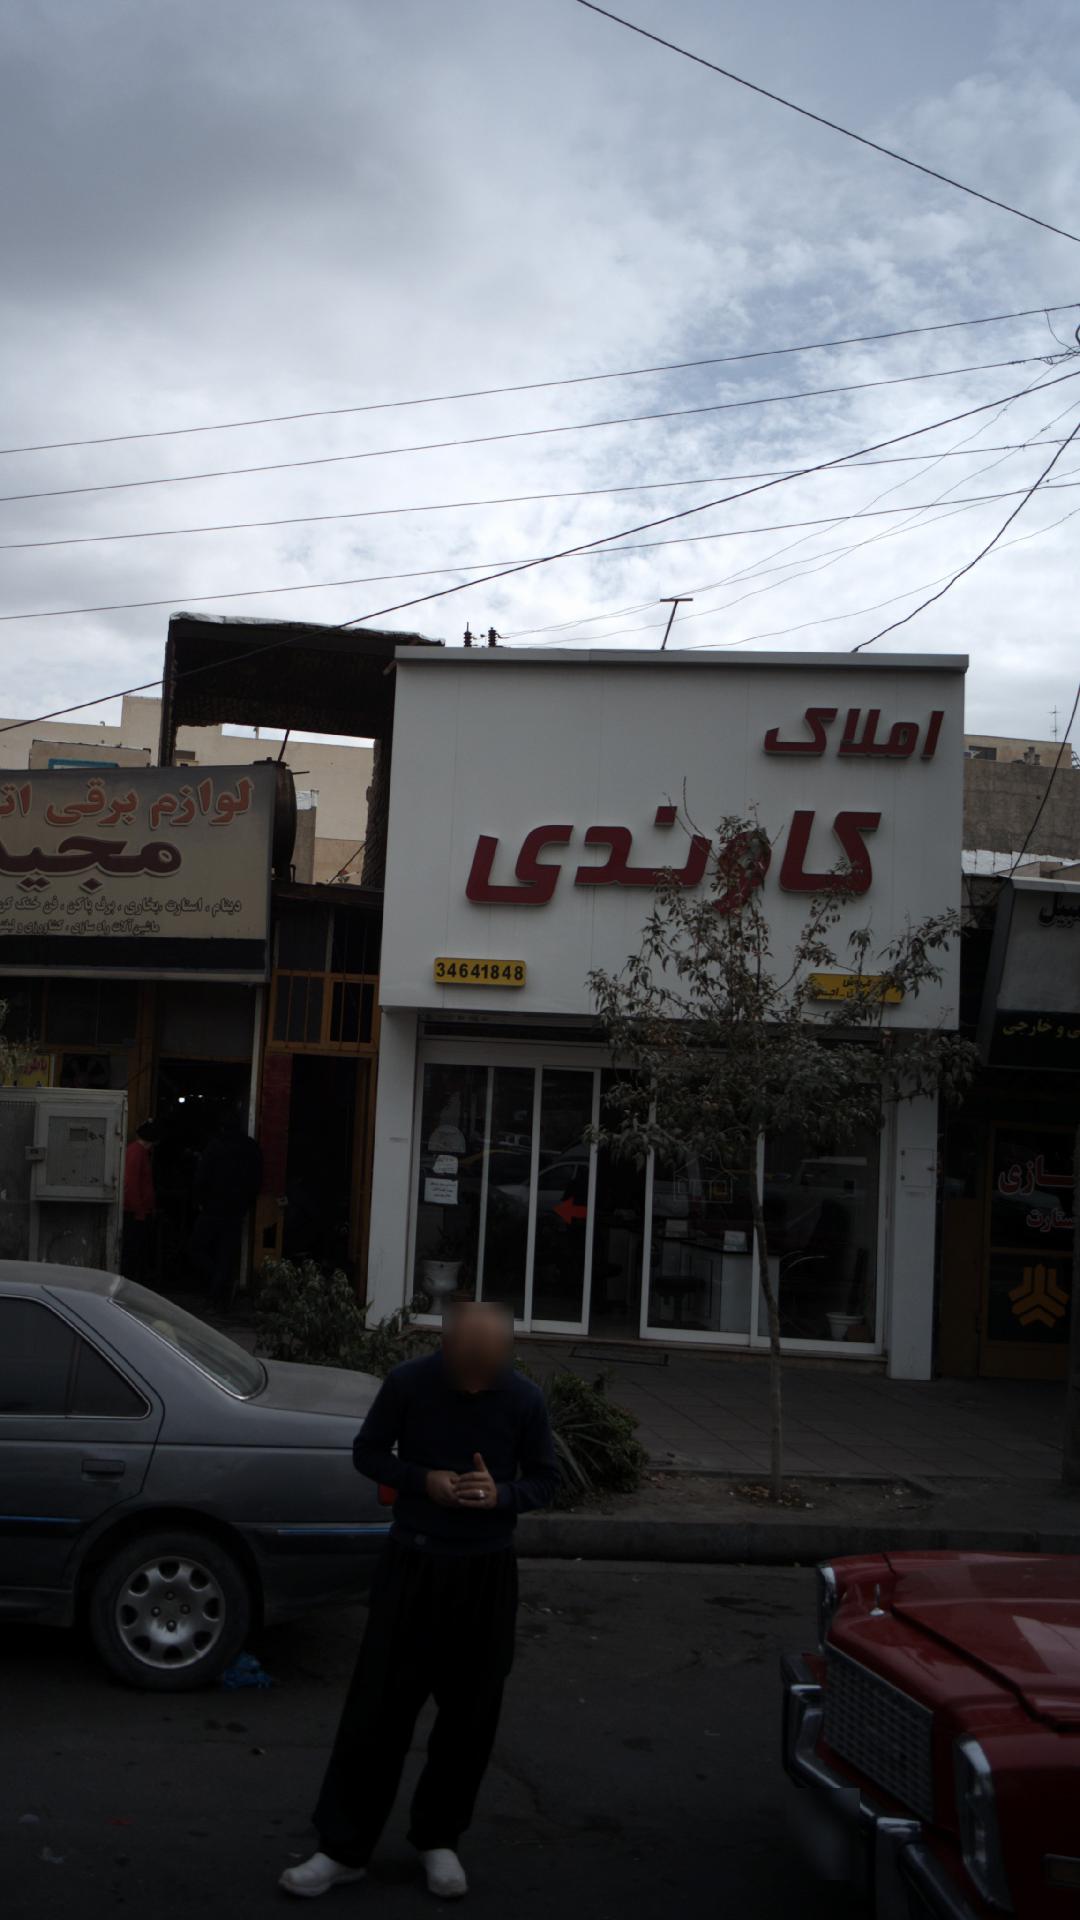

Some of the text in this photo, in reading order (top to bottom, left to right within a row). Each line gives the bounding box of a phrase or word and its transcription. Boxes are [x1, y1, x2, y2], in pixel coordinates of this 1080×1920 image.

[764, 707, 945, 760] املاک
[46, 777, 139, 827] برقی
[150, 776, 254, 829] لوازم
[436, 962, 524, 980] 34641848
